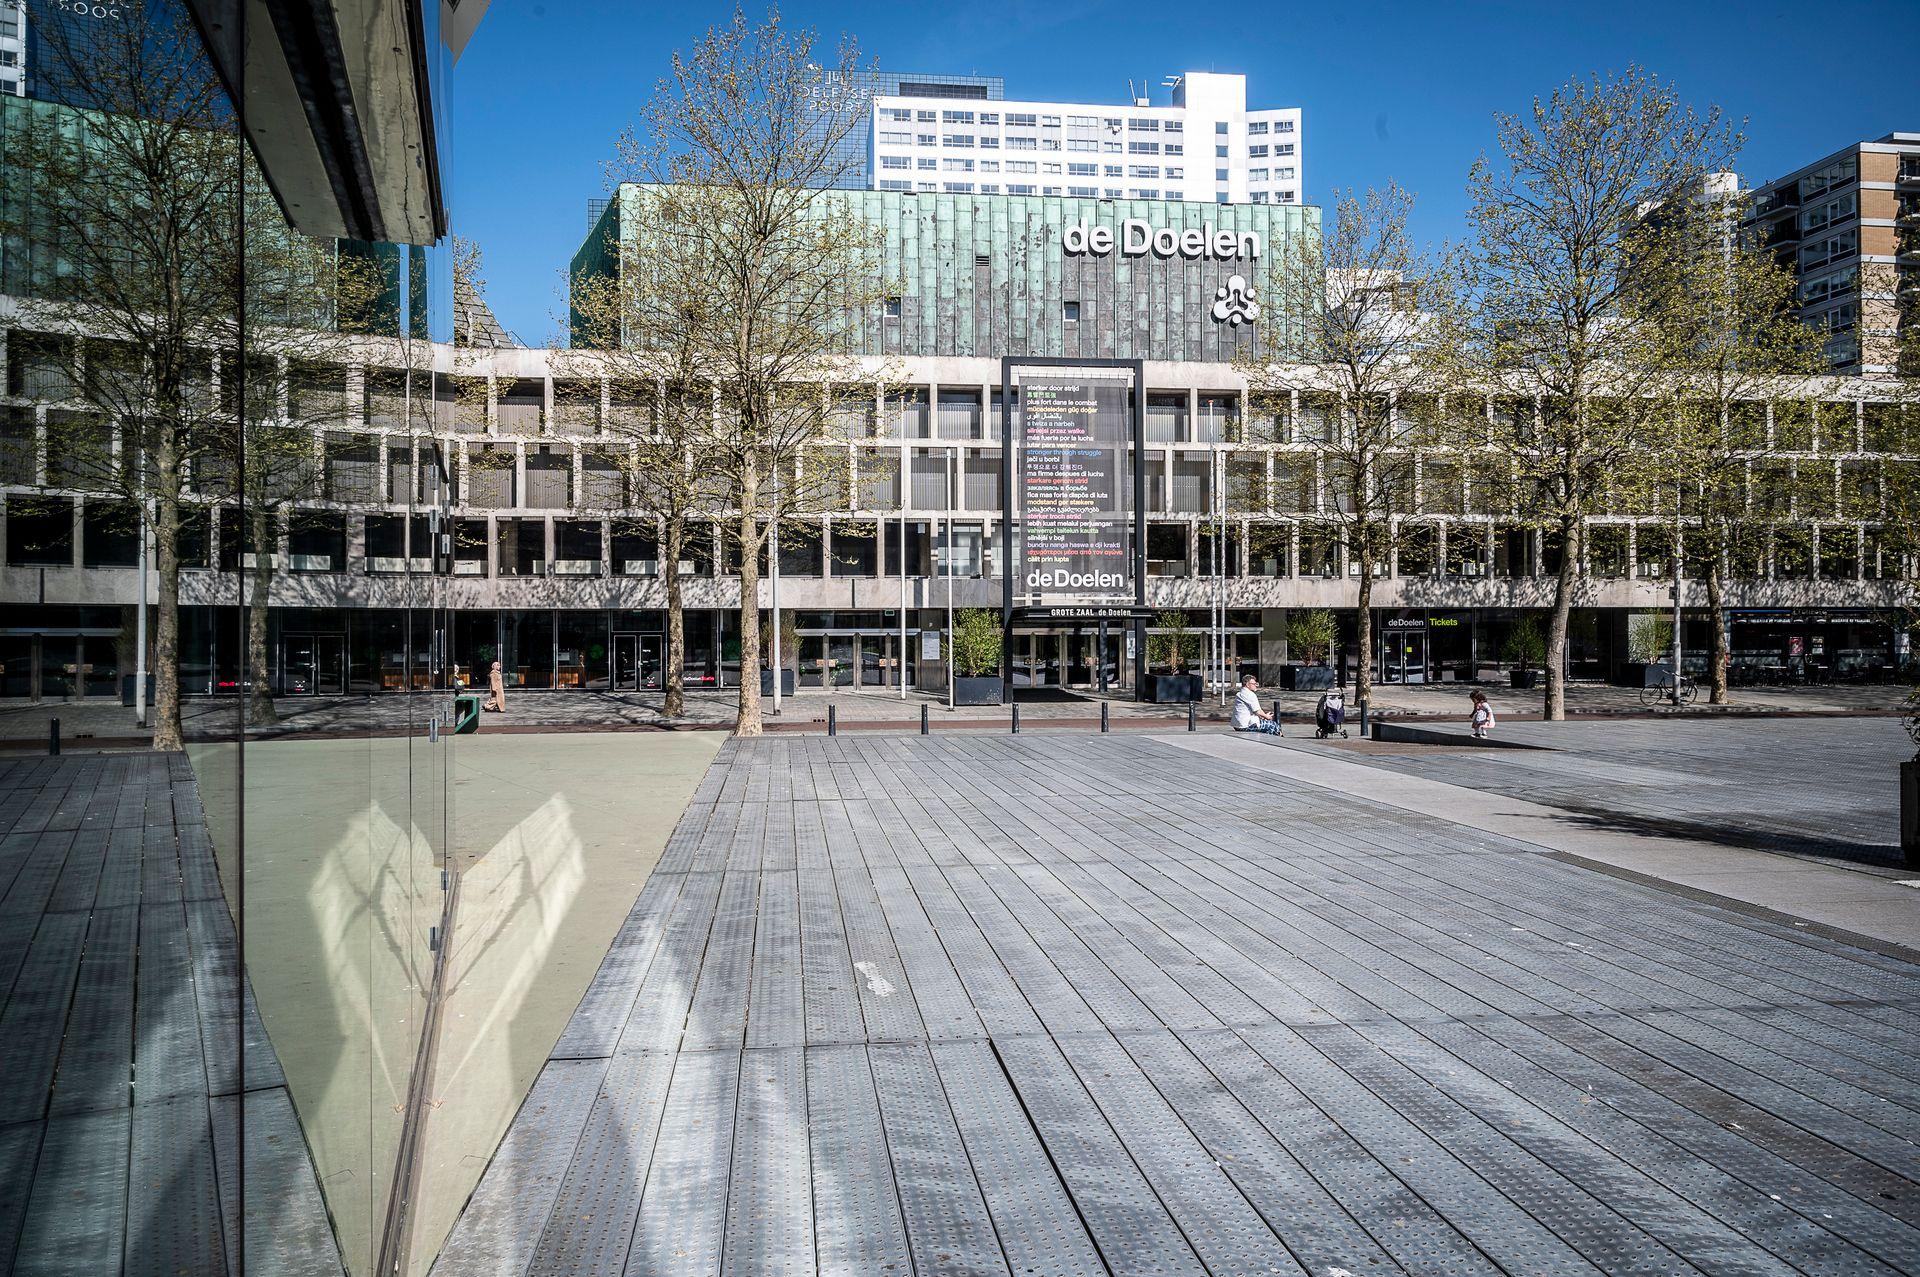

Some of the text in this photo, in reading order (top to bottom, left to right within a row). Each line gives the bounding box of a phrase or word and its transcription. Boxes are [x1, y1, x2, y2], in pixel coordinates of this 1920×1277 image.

[809, 101, 862, 113] POORT
[1063, 217, 1261, 258] de Doelen
[1429, 618, 1458, 626] Tickets
